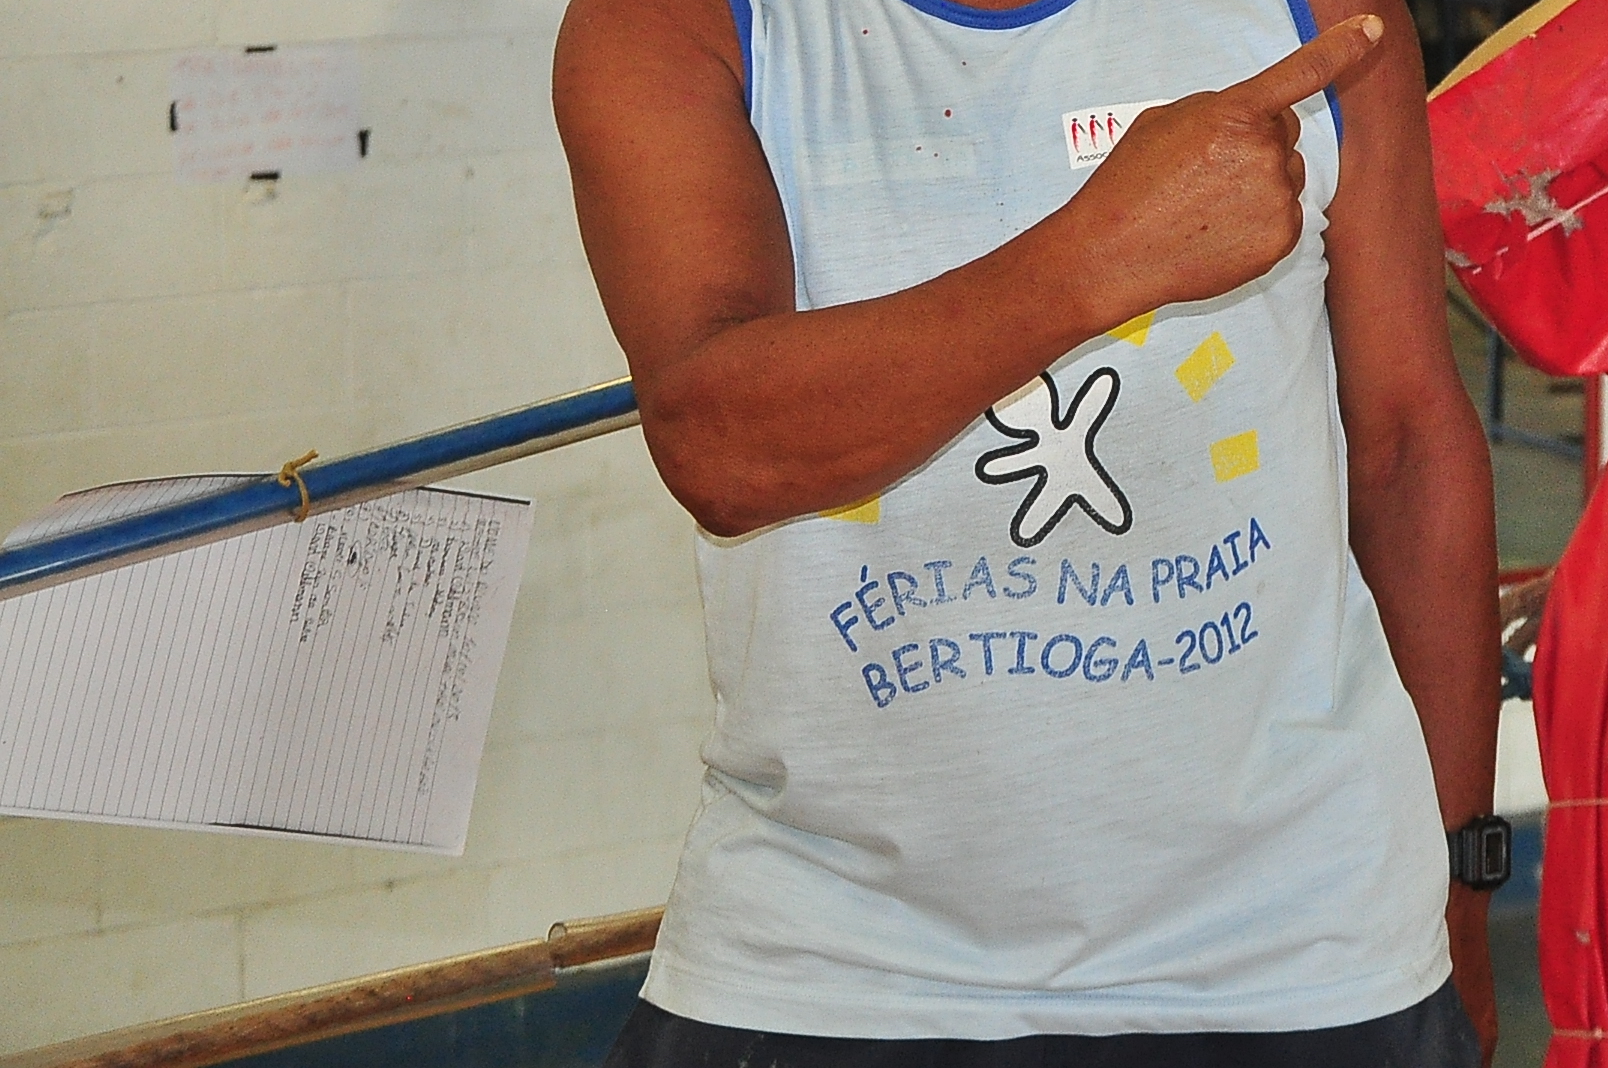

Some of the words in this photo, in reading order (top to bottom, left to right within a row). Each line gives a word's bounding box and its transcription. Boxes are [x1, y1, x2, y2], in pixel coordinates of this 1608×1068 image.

[830, 556, 1038, 653] FÉRIAS
[1056, 558, 1135, 607] NA
[1151, 517, 1272, 604] PRAIA
[861, 601, 1259, 708] BERTIOGA-2012
